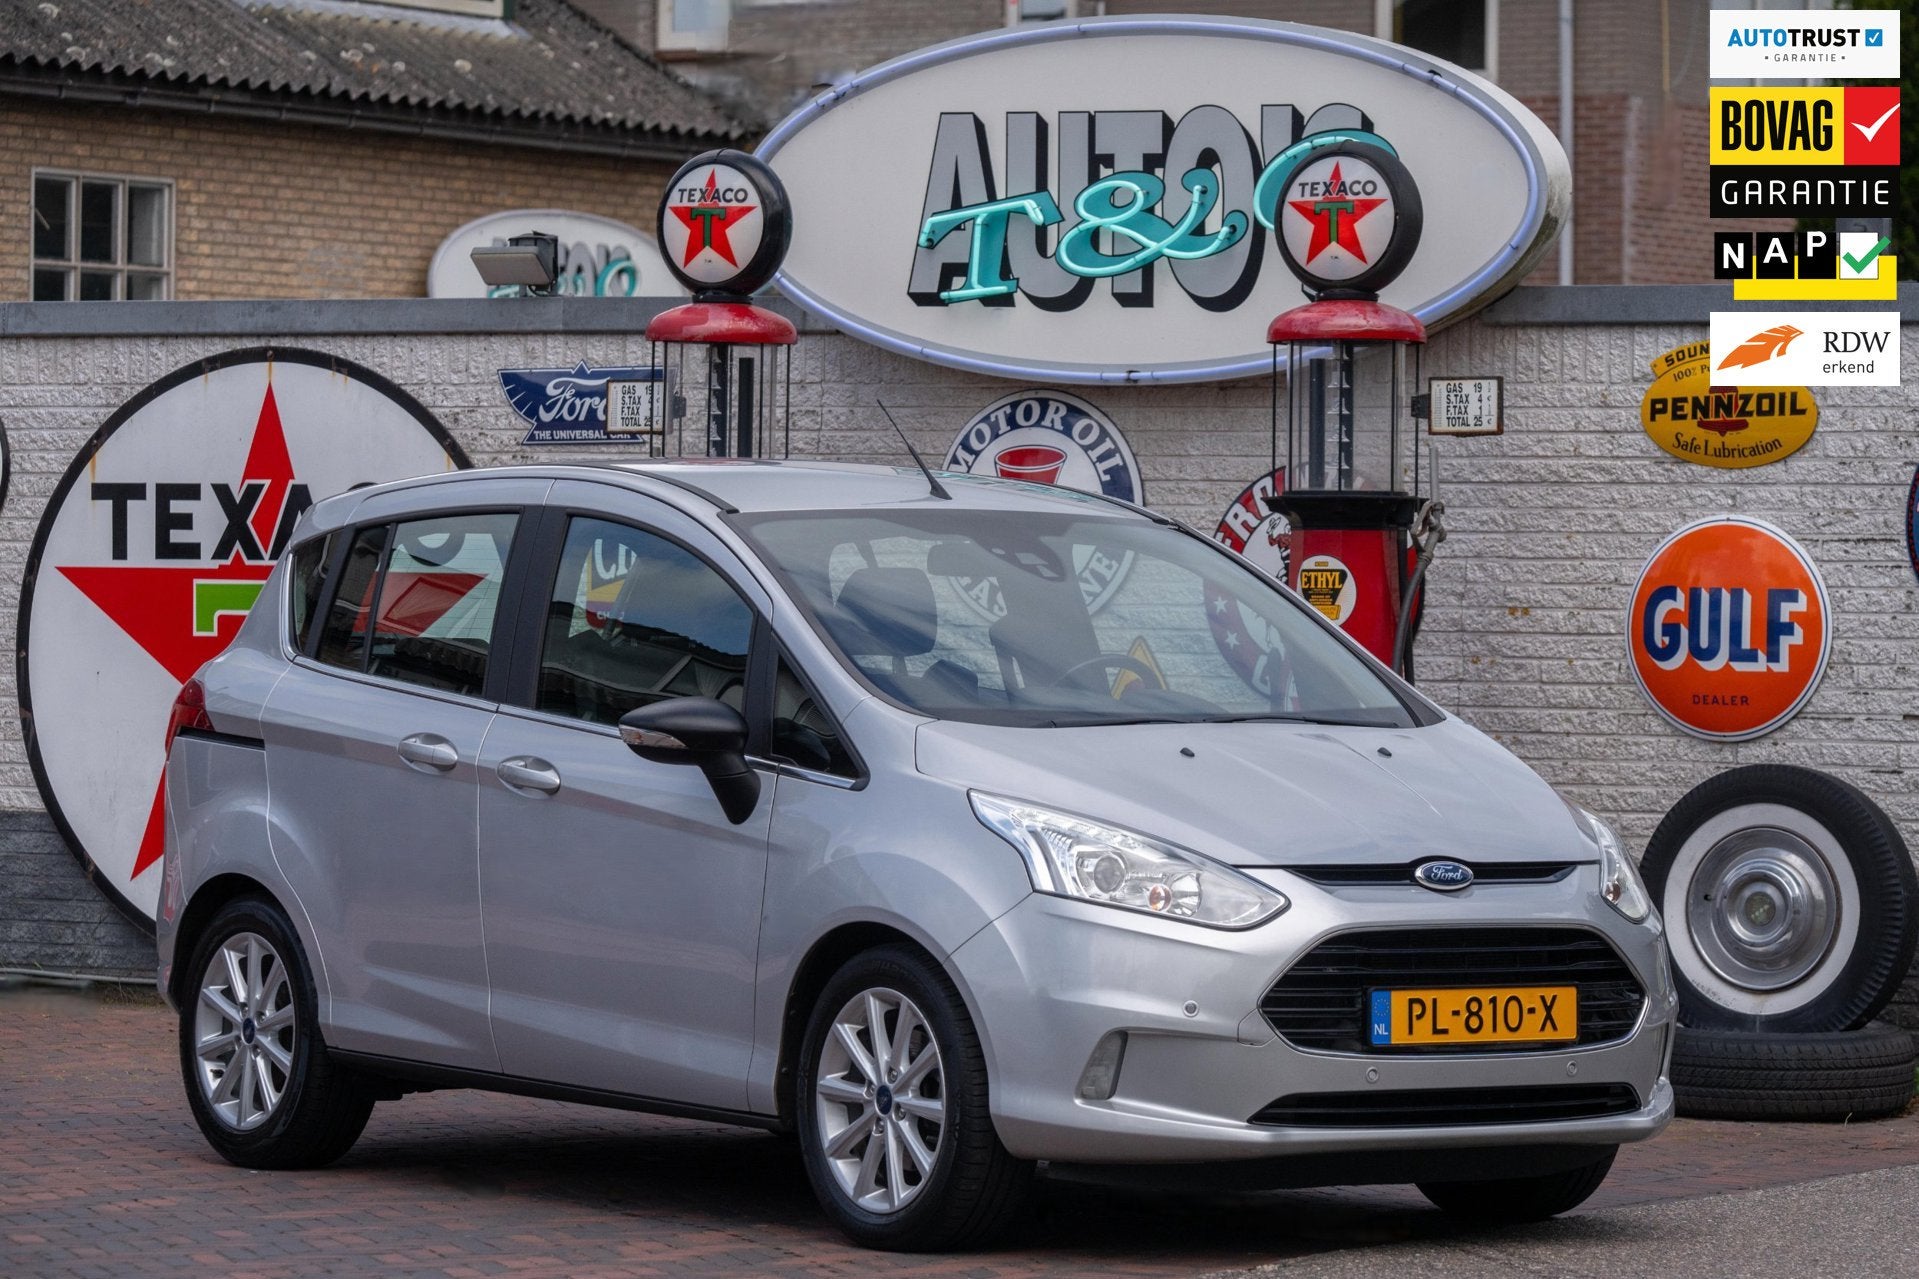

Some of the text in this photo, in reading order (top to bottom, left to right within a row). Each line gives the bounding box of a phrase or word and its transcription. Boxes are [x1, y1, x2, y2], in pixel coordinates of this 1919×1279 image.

[678, 187, 748, 203] TEXACO
[1299, 179, 1377, 197] TEXACO
[907, 102, 1374, 313] AUTO'
[691, 207, 726, 248] T
[1314, 200, 1355, 243] T
[1665, 343, 1709, 367] SOUN
[1673, 367, 1697, 382] 100%
[621, 385, 636, 395] GAS
[1446, 383, 1463, 393] GAS
[1473, 382, 1483, 393] 19
[539, 376, 611, 423] For
[621, 396, 641, 405] S.TAX
[1446, 394, 1470, 404] S.TAX
[1650, 391, 1808, 422] PENNZOIL
[621, 406, 640, 416] F.TAX
[1446, 405, 1469, 416] F.TAX
[621, 417, 641, 427] TOTAL
[1446, 416, 1471, 427] TOTAL
[1473, 416, 1483, 427] 25
[534, 430, 551, 440] THE
[553, 430, 607, 440] UNIVERSAL
[1072, 417, 1123, 482] OIL
[1672, 431, 1782, 458] Safe Lubrication
[91, 482, 314, 561] TEXA
[1301, 571, 1343, 588] ETHYL
[1643, 585, 1807, 672] GULF
[1692, 694, 1750, 706] DEALER
[1430, 864, 1464, 881] Ford
[1407, 994, 1558, 1036] PL-810-X
[1374, 1023, 1388, 1035] NL
